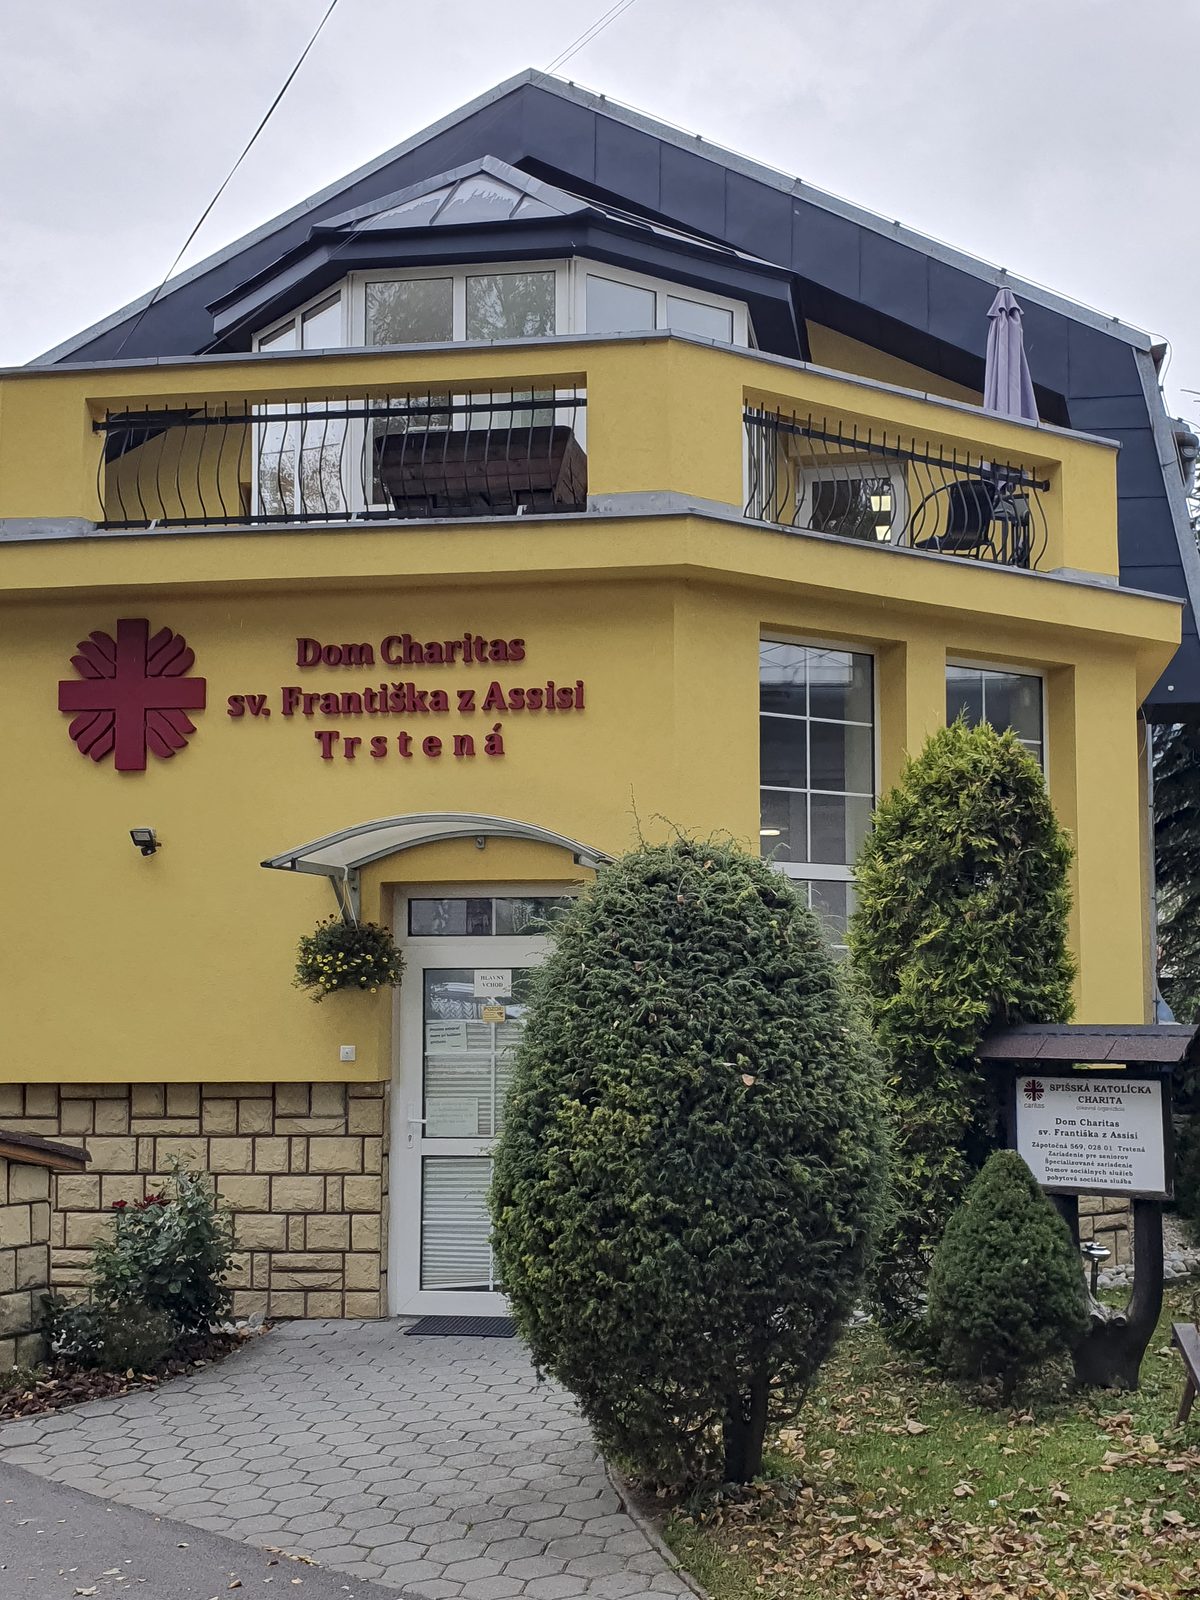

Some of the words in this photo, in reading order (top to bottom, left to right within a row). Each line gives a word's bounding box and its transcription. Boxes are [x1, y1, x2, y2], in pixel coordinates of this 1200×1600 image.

[296, 637, 375, 667] Dom
[380, 633, 526, 665] Charitas
[227, 694, 271, 717] sv.
[281, 682, 449, 716] Františka
[457, 689, 475, 712] z
[481, 680, 585, 712] Assisi
[314, 723, 505, 760] Trstená
[1049, 1083, 1091, 1093] SPIŠSKÁ
[1093, 1084, 1152, 1095] KATOLÍCKA
[1078, 1095, 1123, 1105] CHARITA
[1055, 1117, 1077, 1126] Dom
[1079, 1118, 1120, 1128] Charitas
[1054, 1128, 1099, 1138] Františka
[1110, 1131, 1138, 1140] Assisi
[1031, 1141, 1068, 1150] Zápotočná
[1117, 1145, 1146, 1153] Trstená
